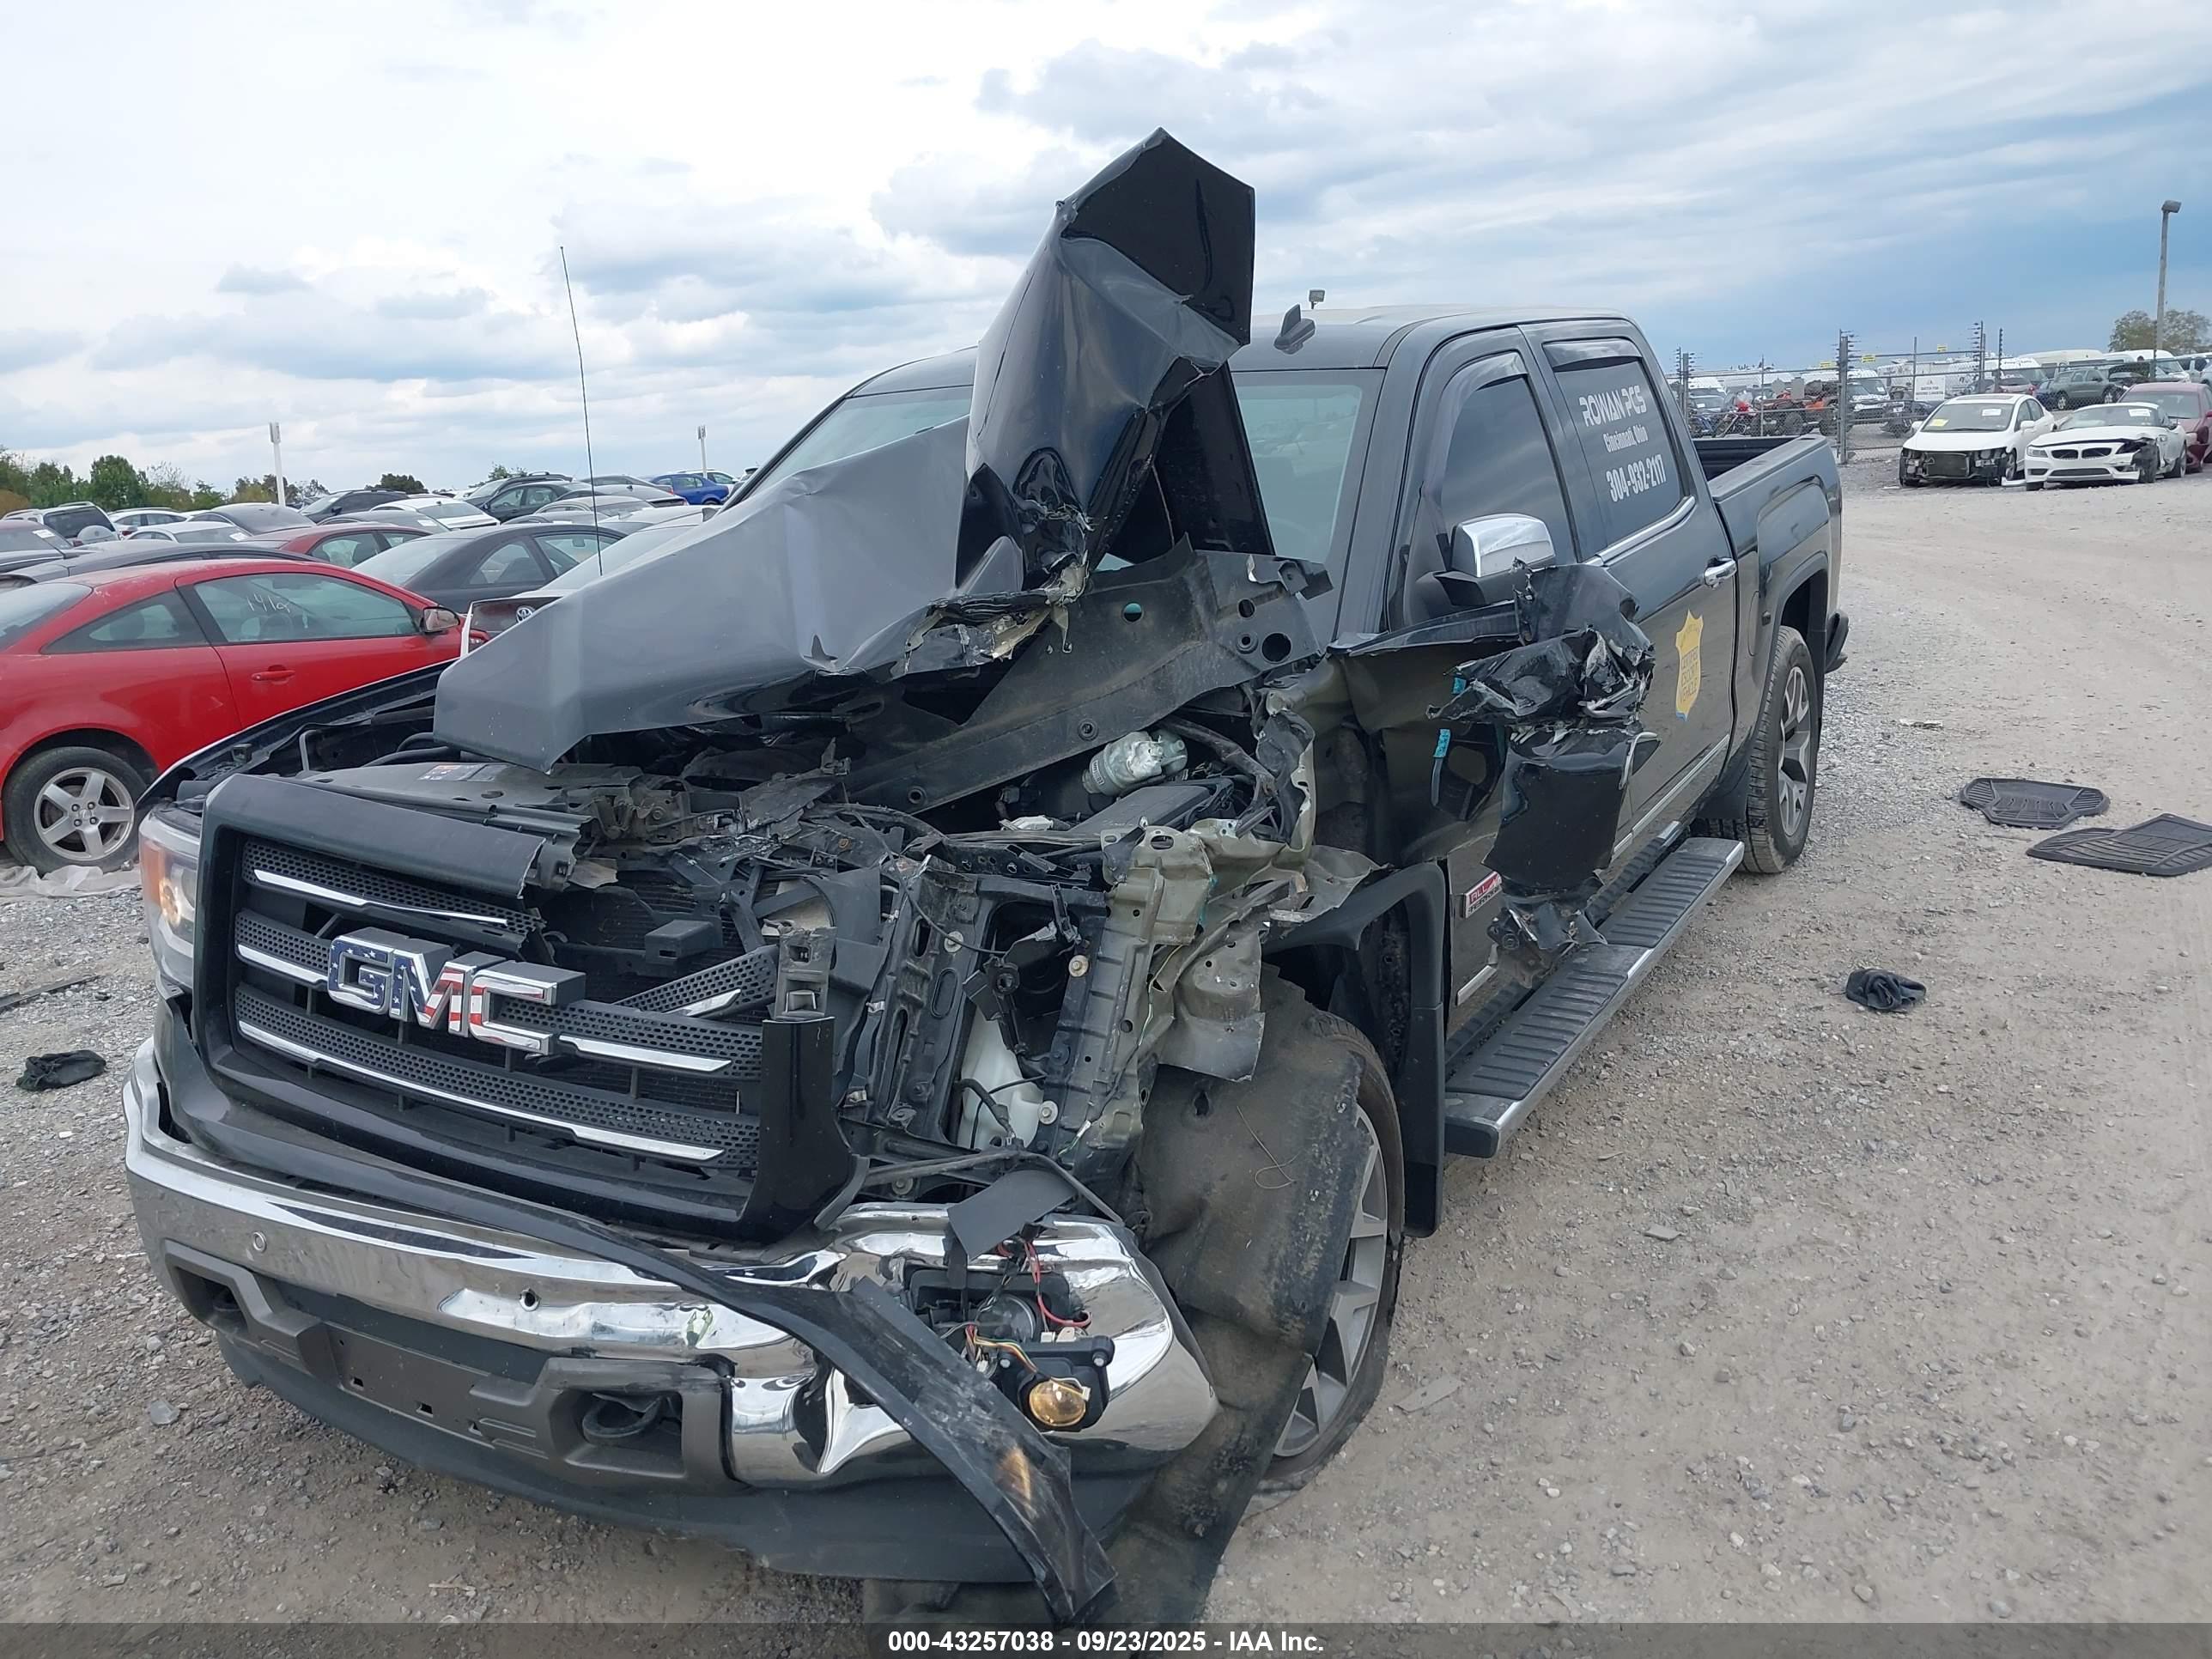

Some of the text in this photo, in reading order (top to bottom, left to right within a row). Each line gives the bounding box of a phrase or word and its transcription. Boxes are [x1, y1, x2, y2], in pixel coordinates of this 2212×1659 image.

[1578, 386, 1647, 427] ROWAN PCS
[1606, 454, 1667, 502] 304-932-2117
[328, 933, 563, 1056] GMC
